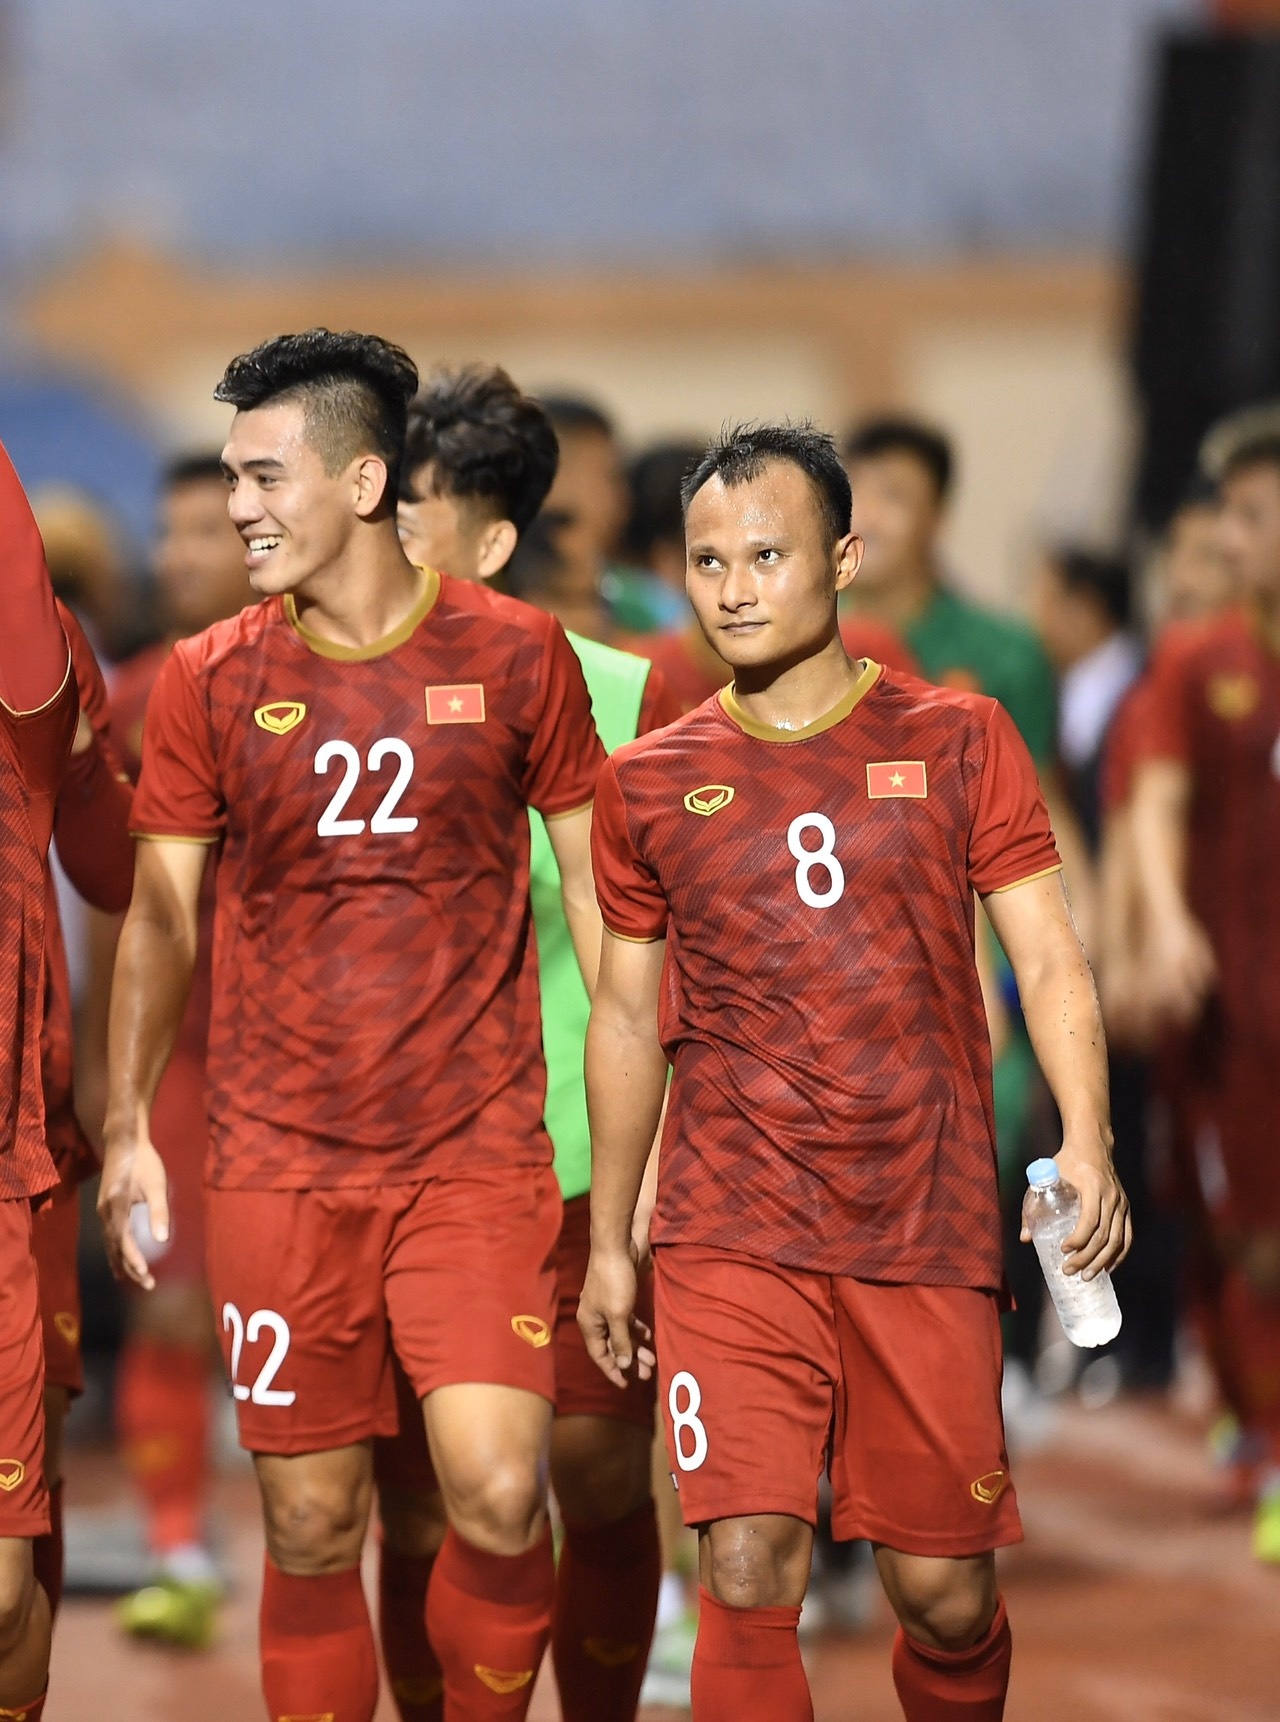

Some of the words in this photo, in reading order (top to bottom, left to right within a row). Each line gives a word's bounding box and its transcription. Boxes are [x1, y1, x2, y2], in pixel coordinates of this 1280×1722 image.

[314, 737, 419, 837] 22
[787, 812, 845, 909] 8
[222, 1302, 296, 1407] 22
[668, 1371, 708, 1472] 8
